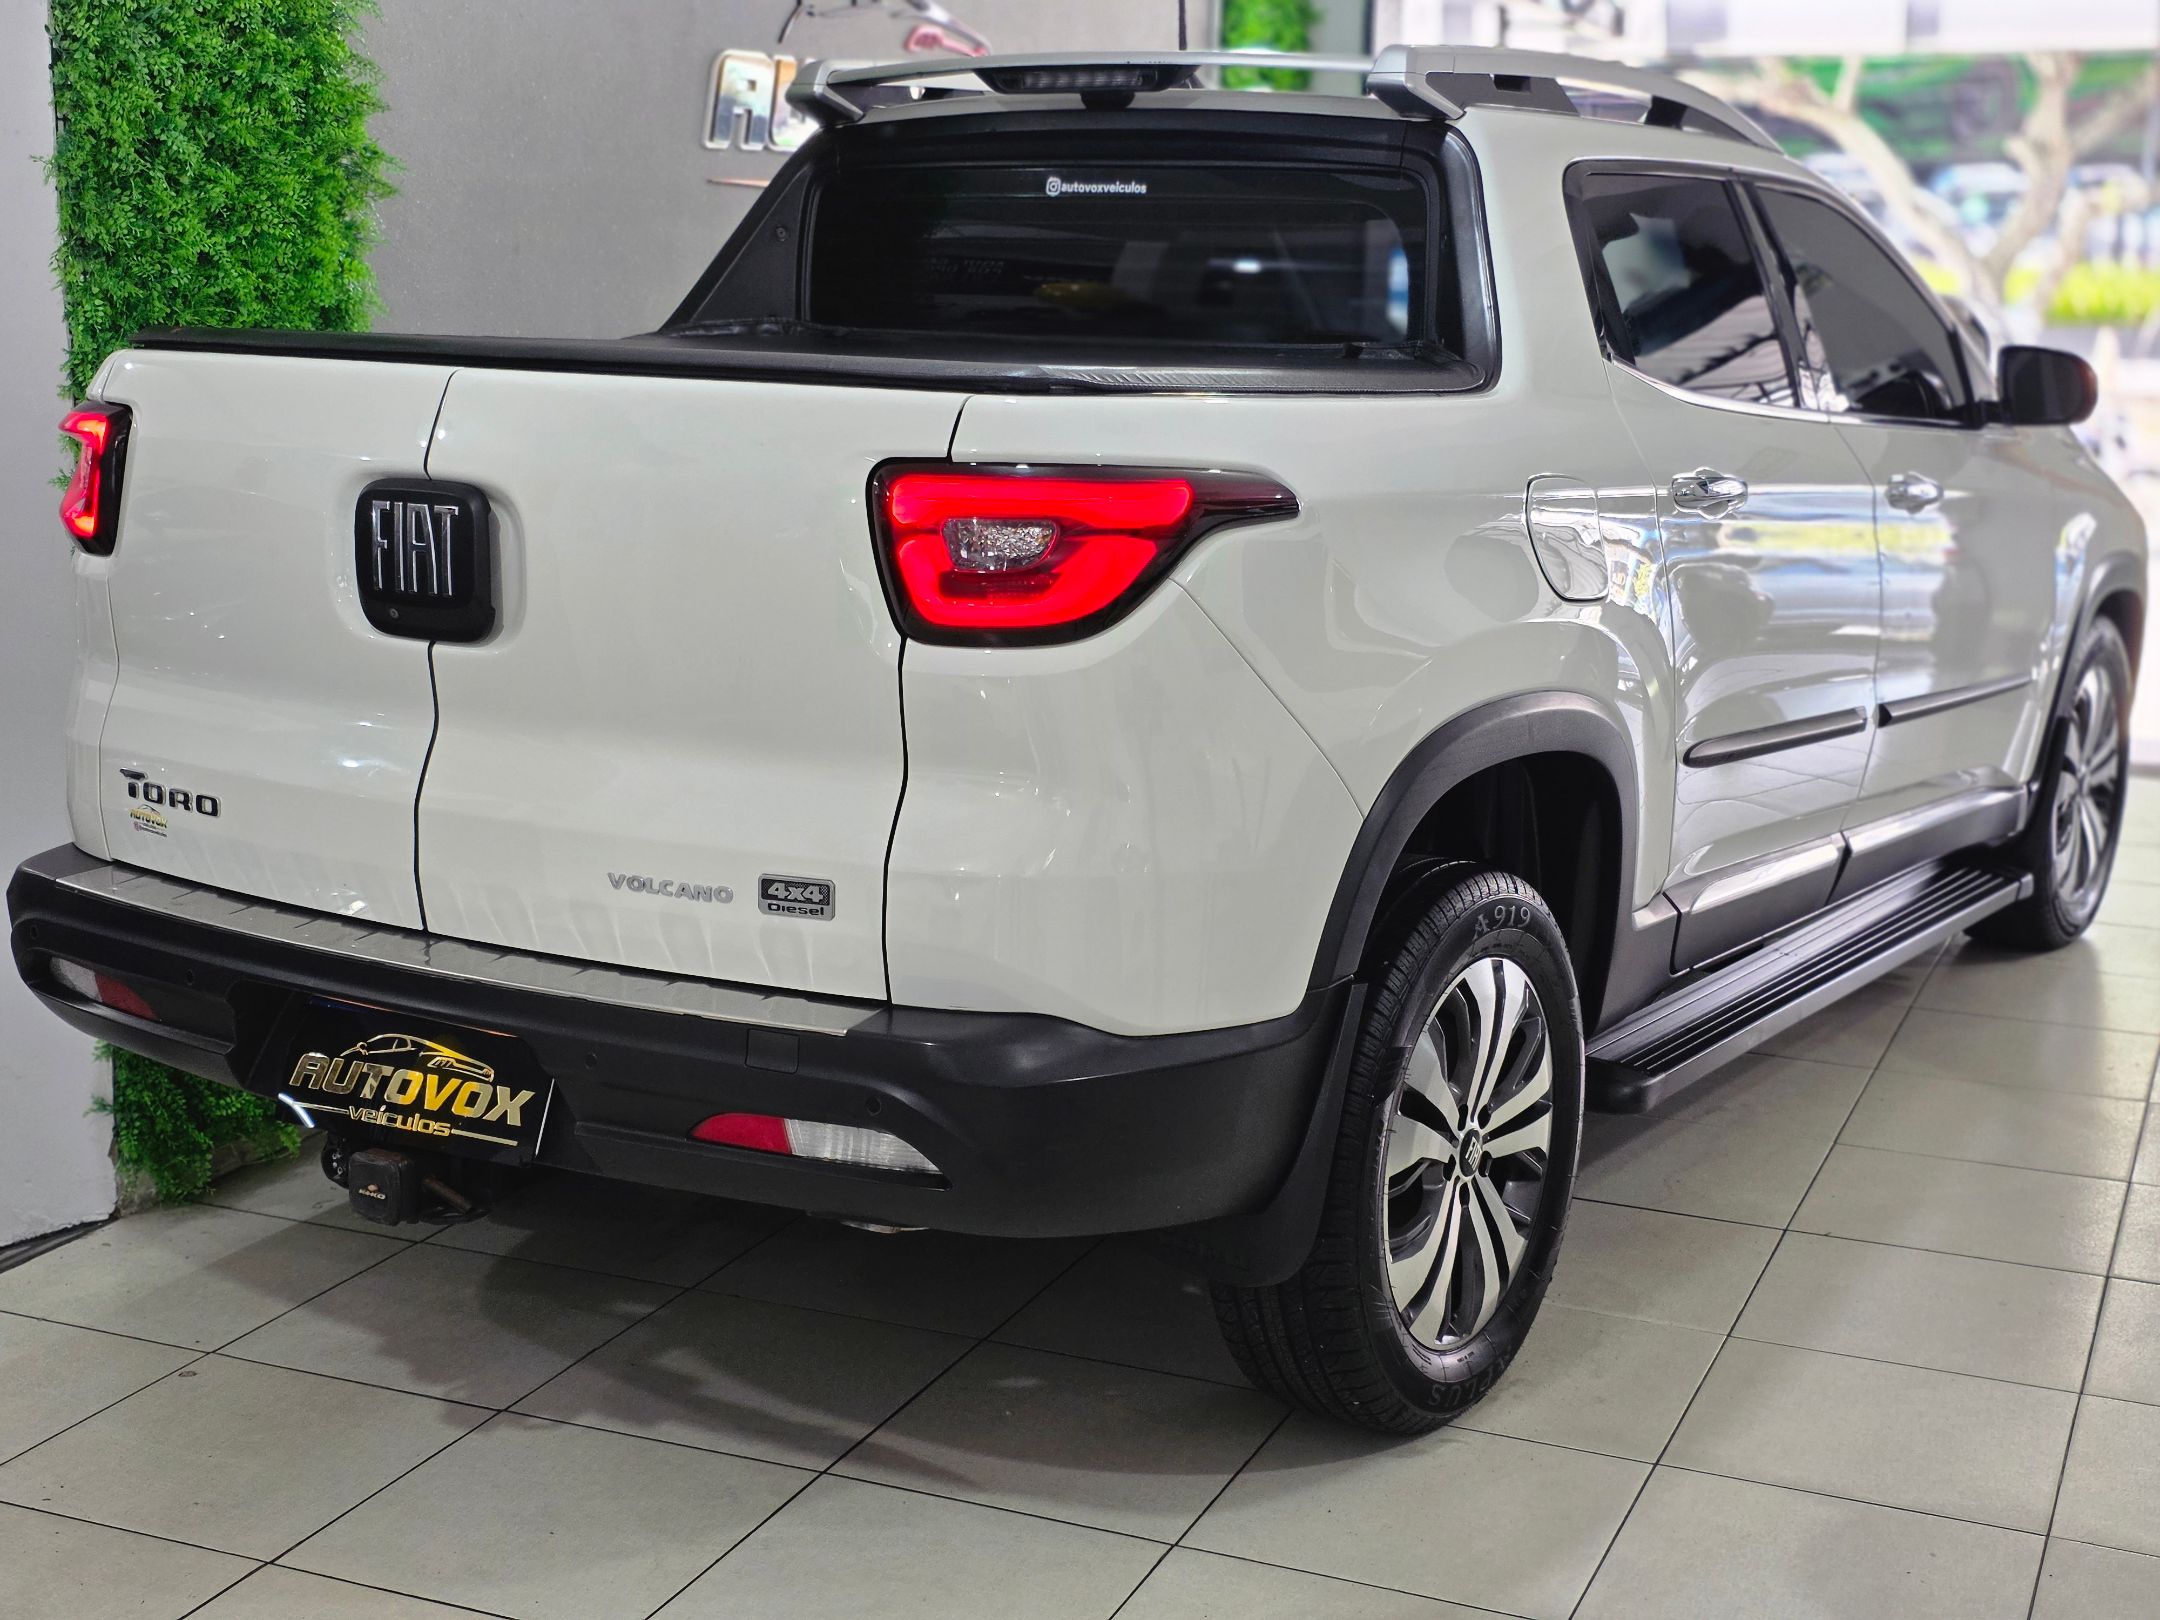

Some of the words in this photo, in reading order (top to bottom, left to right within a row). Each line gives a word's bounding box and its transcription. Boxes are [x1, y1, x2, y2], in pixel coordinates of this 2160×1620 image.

[1061, 181, 1147, 194] autovoxveiculos
[372, 500, 459, 596] FIAT
[120, 767, 222, 818] TORO
[607, 872, 734, 904] VOLCANO
[767, 903, 824, 916] Diesel
[289, 1052, 536, 1126] AUTOVOX
